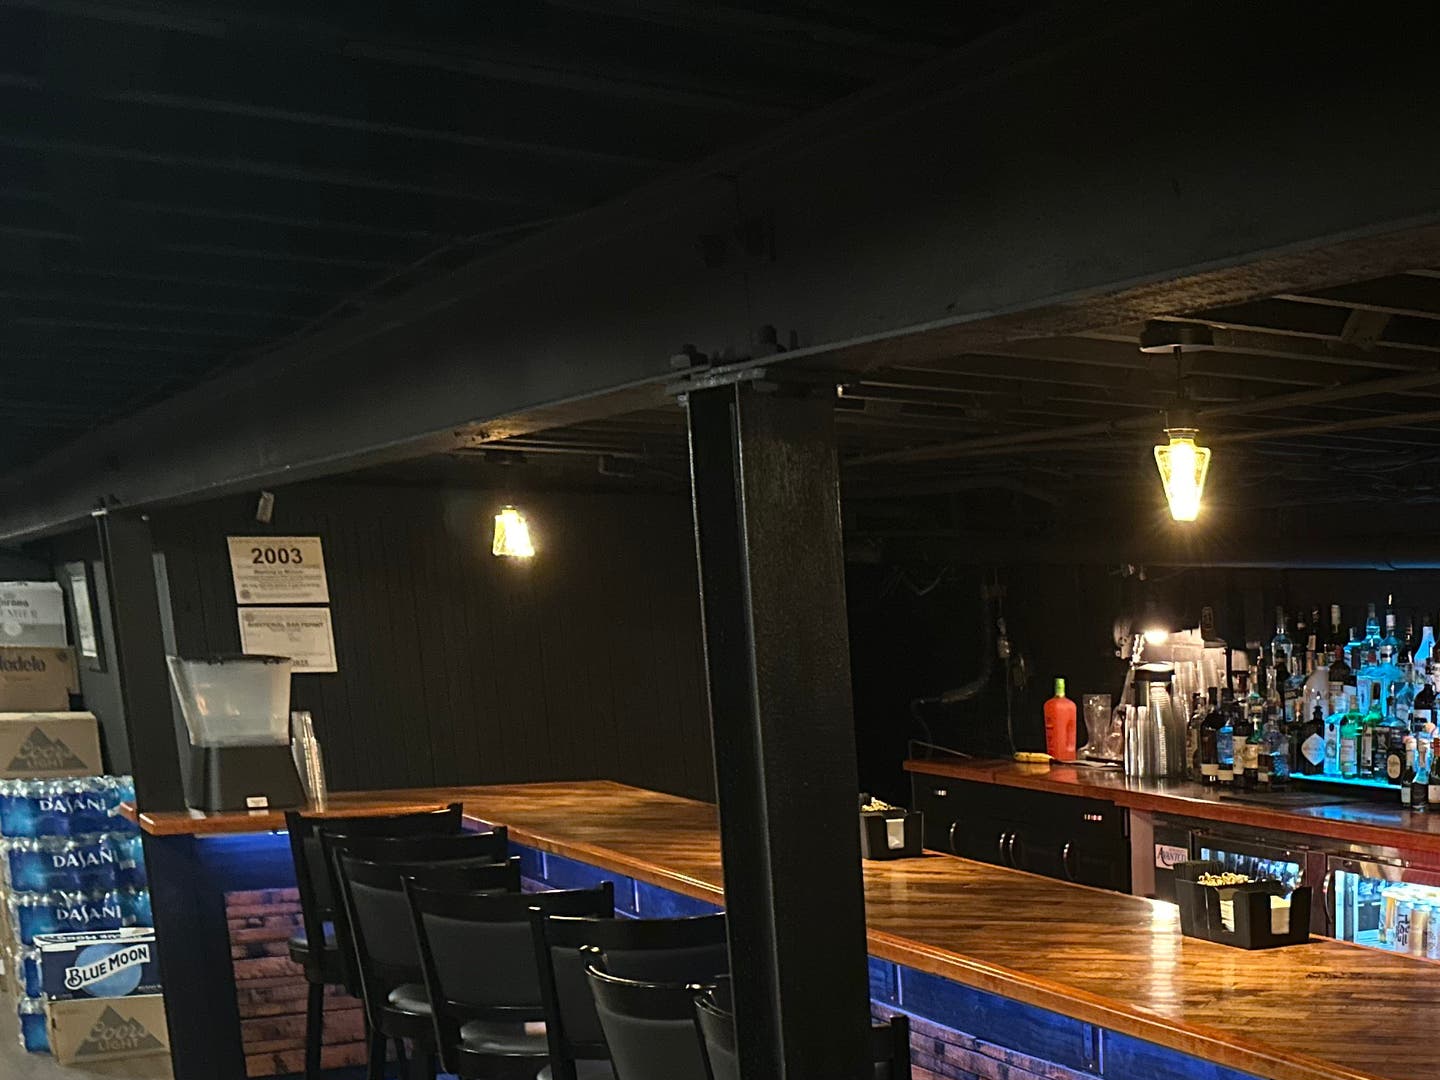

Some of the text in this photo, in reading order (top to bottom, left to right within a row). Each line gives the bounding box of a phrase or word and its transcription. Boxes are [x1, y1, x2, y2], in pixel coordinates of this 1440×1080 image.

[251, 547, 304, 565] 2003
[0, 655, 47, 672] odelo
[39, 798, 107, 814] DASANI
[52, 848, 119, 869] DASANI
[56, 904, 121, 924] DASANI
[66, 946, 148, 987] BLUE MOON
